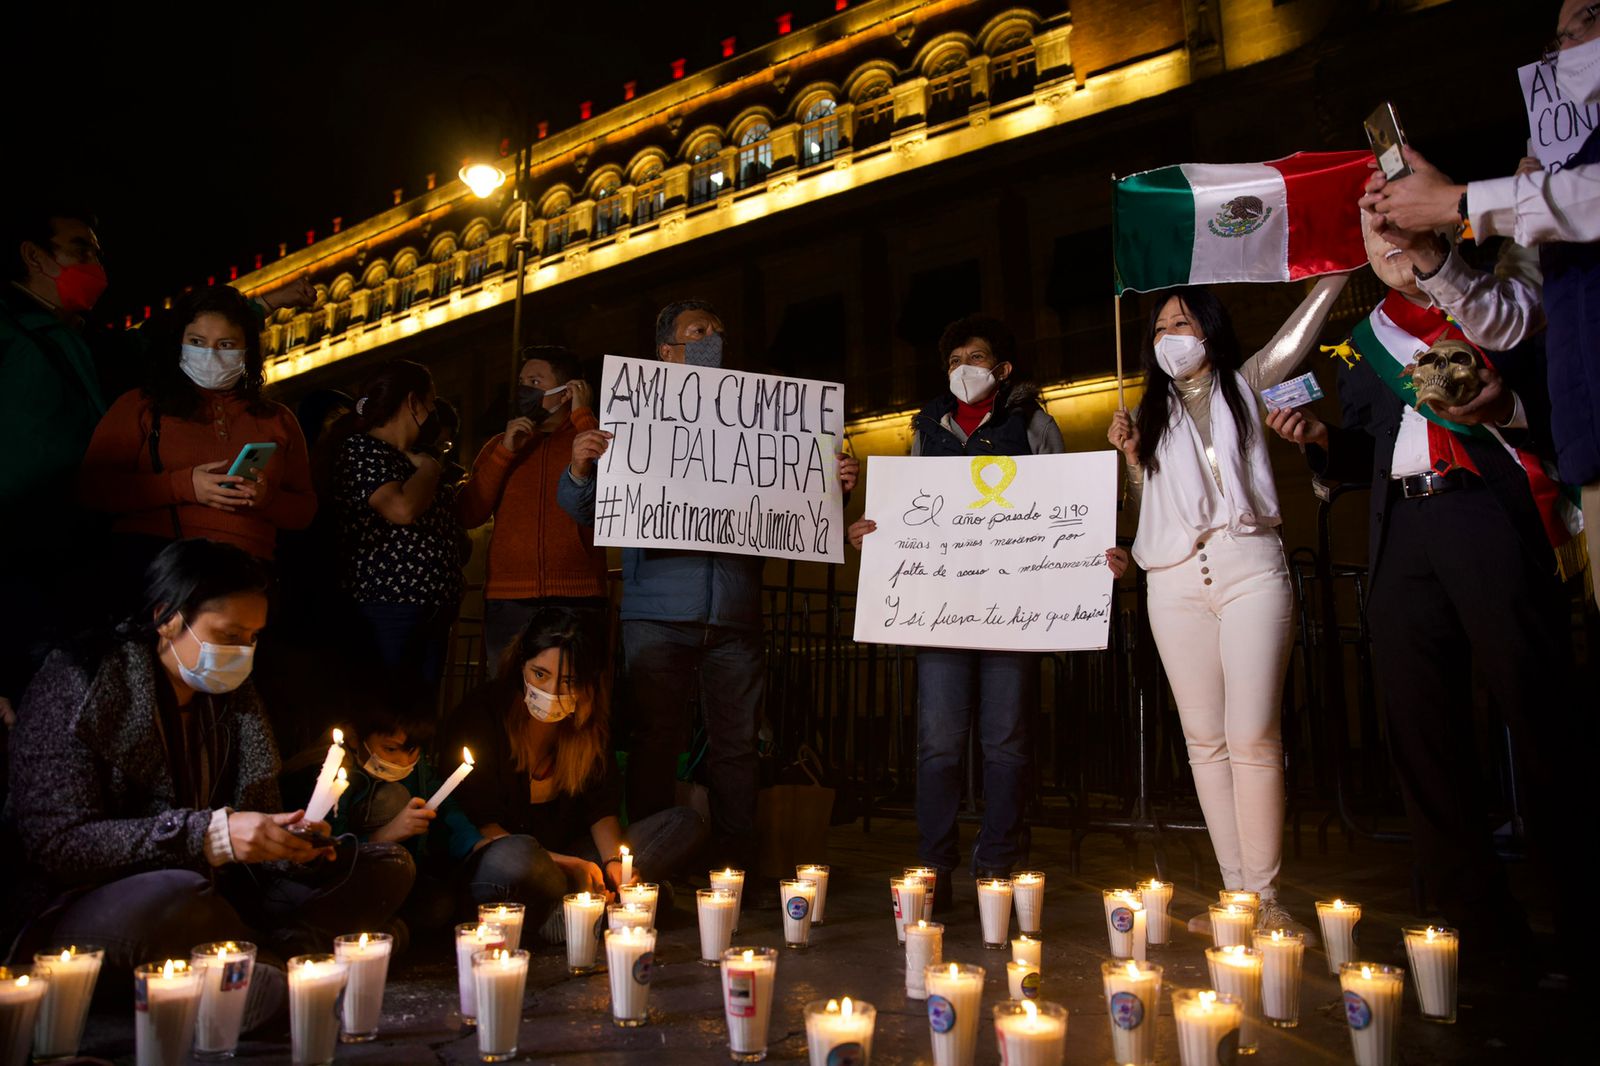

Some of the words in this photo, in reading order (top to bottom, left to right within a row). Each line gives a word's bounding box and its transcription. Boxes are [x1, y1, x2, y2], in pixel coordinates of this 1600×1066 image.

[1538, 100, 1600, 147] CON
[606, 362, 701, 424] AMLO
[714, 374, 837, 436] CUMPLE
[604, 421, 652, 474] TU
[670, 426, 826, 493] PALABRA
[952, 513, 986, 526] año
[987, 501, 1042, 530] pasado
[1049, 504, 1089, 520] 2190
[894, 537, 930, 549] niñas
[940, 542, 948, 555] y
[1052, 532, 1086, 549] por
[888, 560, 928, 588] falta
[932, 564, 947, 577] de
[884, 595, 900, 628] Y
[930, 601, 981, 632] fuera
[982, 602, 1006, 625] tu
[1006, 606, 1041, 631] hijo
[1045, 611, 1070, 632] que
